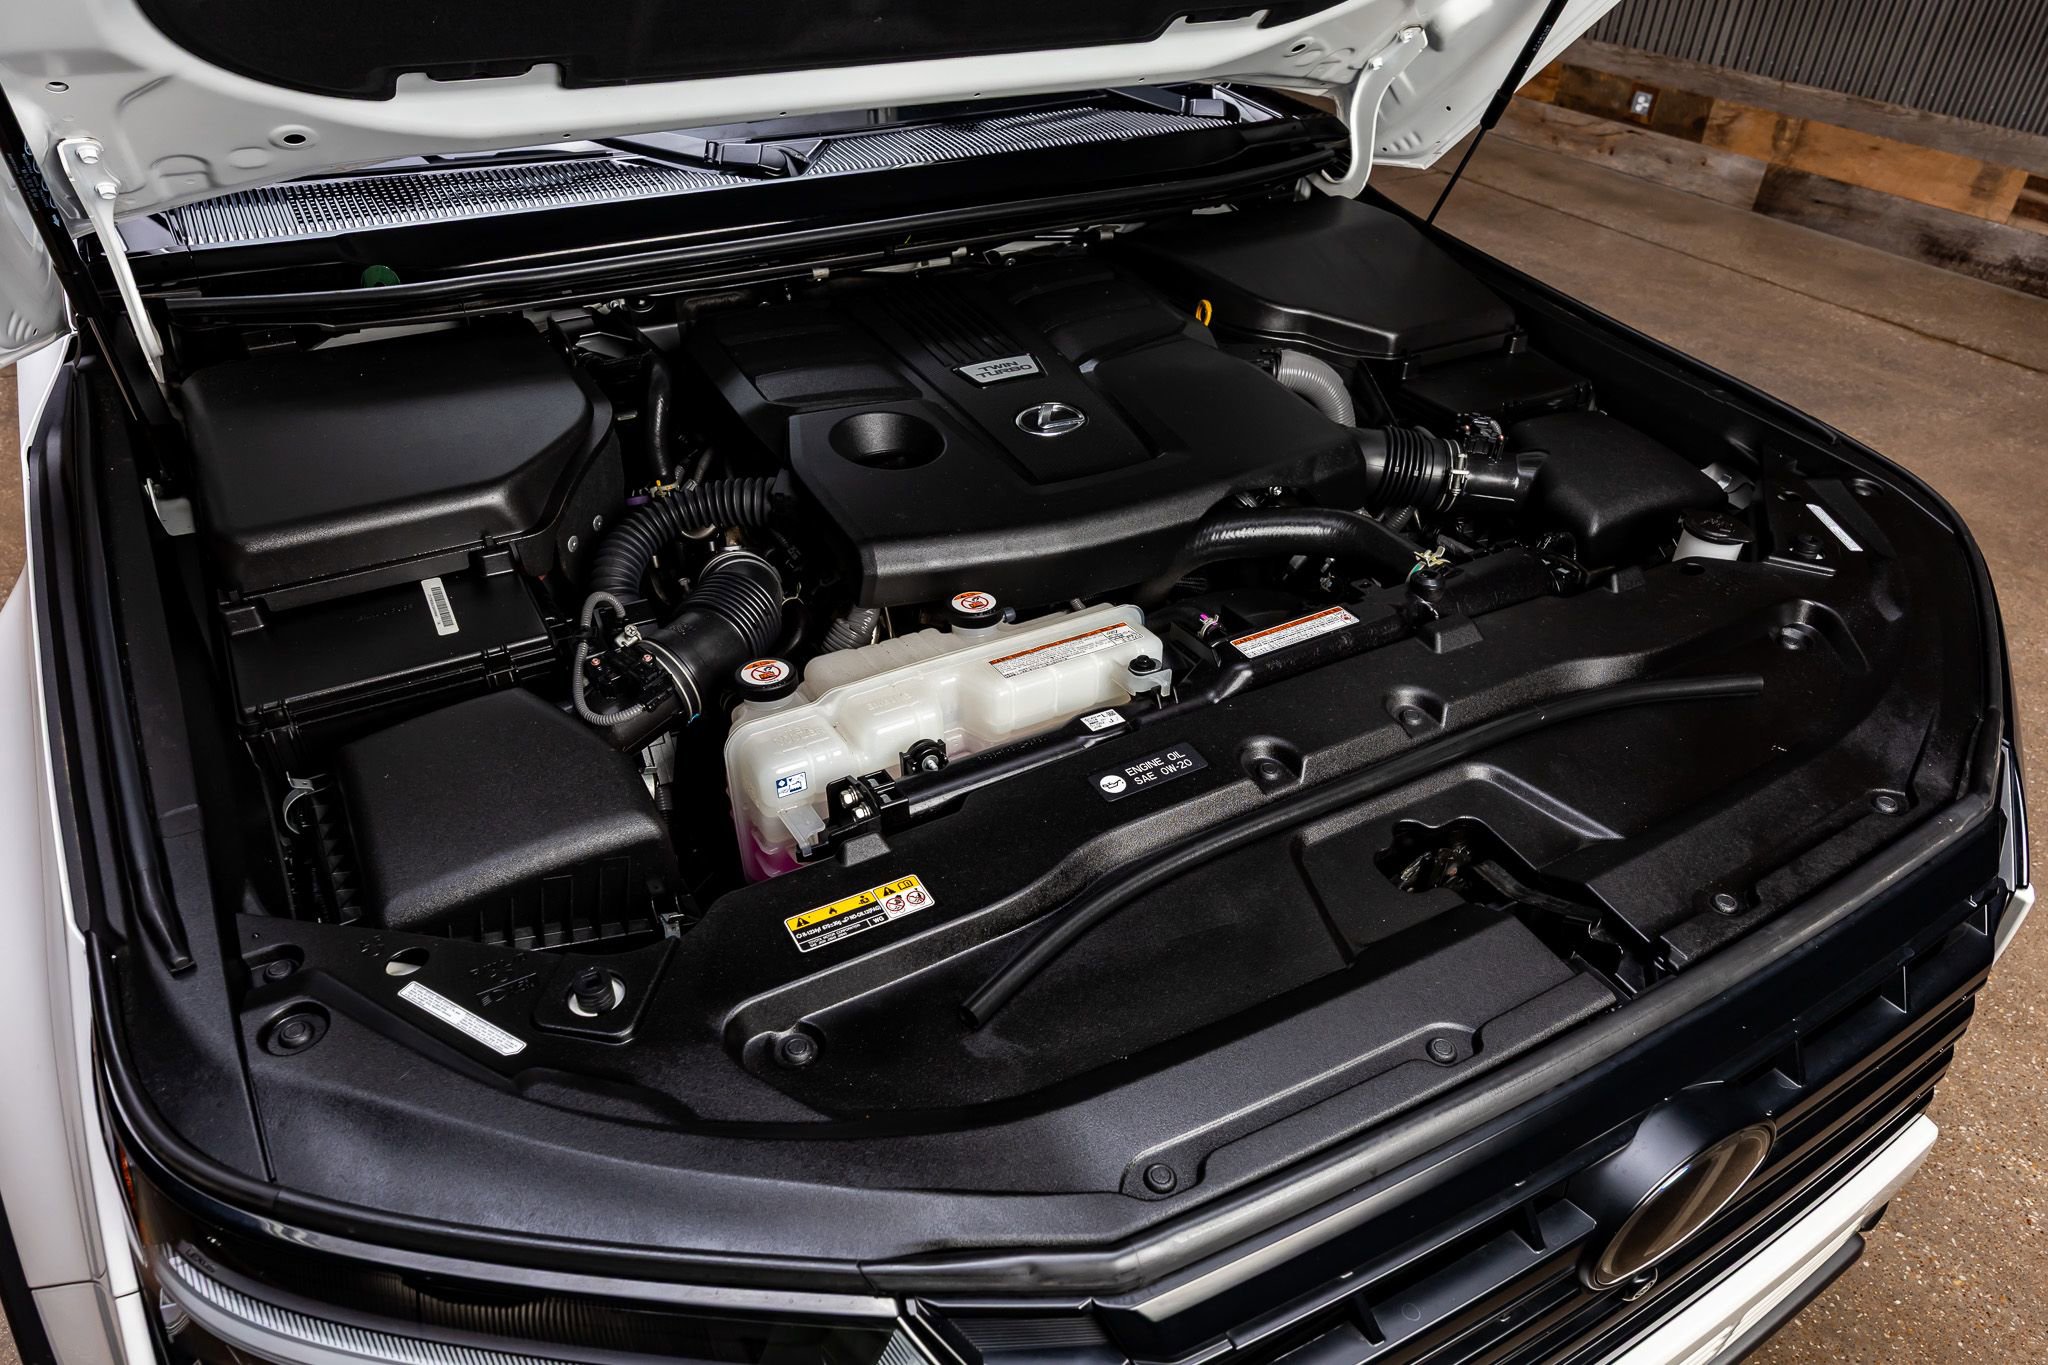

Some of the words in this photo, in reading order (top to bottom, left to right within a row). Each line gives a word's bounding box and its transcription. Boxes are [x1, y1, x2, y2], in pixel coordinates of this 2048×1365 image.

[976, 364, 1032, 378] TURBO
[978, 360, 1018, 371] TWIN
[1125, 757, 1164, 776] ENGINE
[1167, 750, 1186, 761] OIL
[1134, 771, 1158, 785] SAE
[1160, 758, 1193, 775] 0W-20
